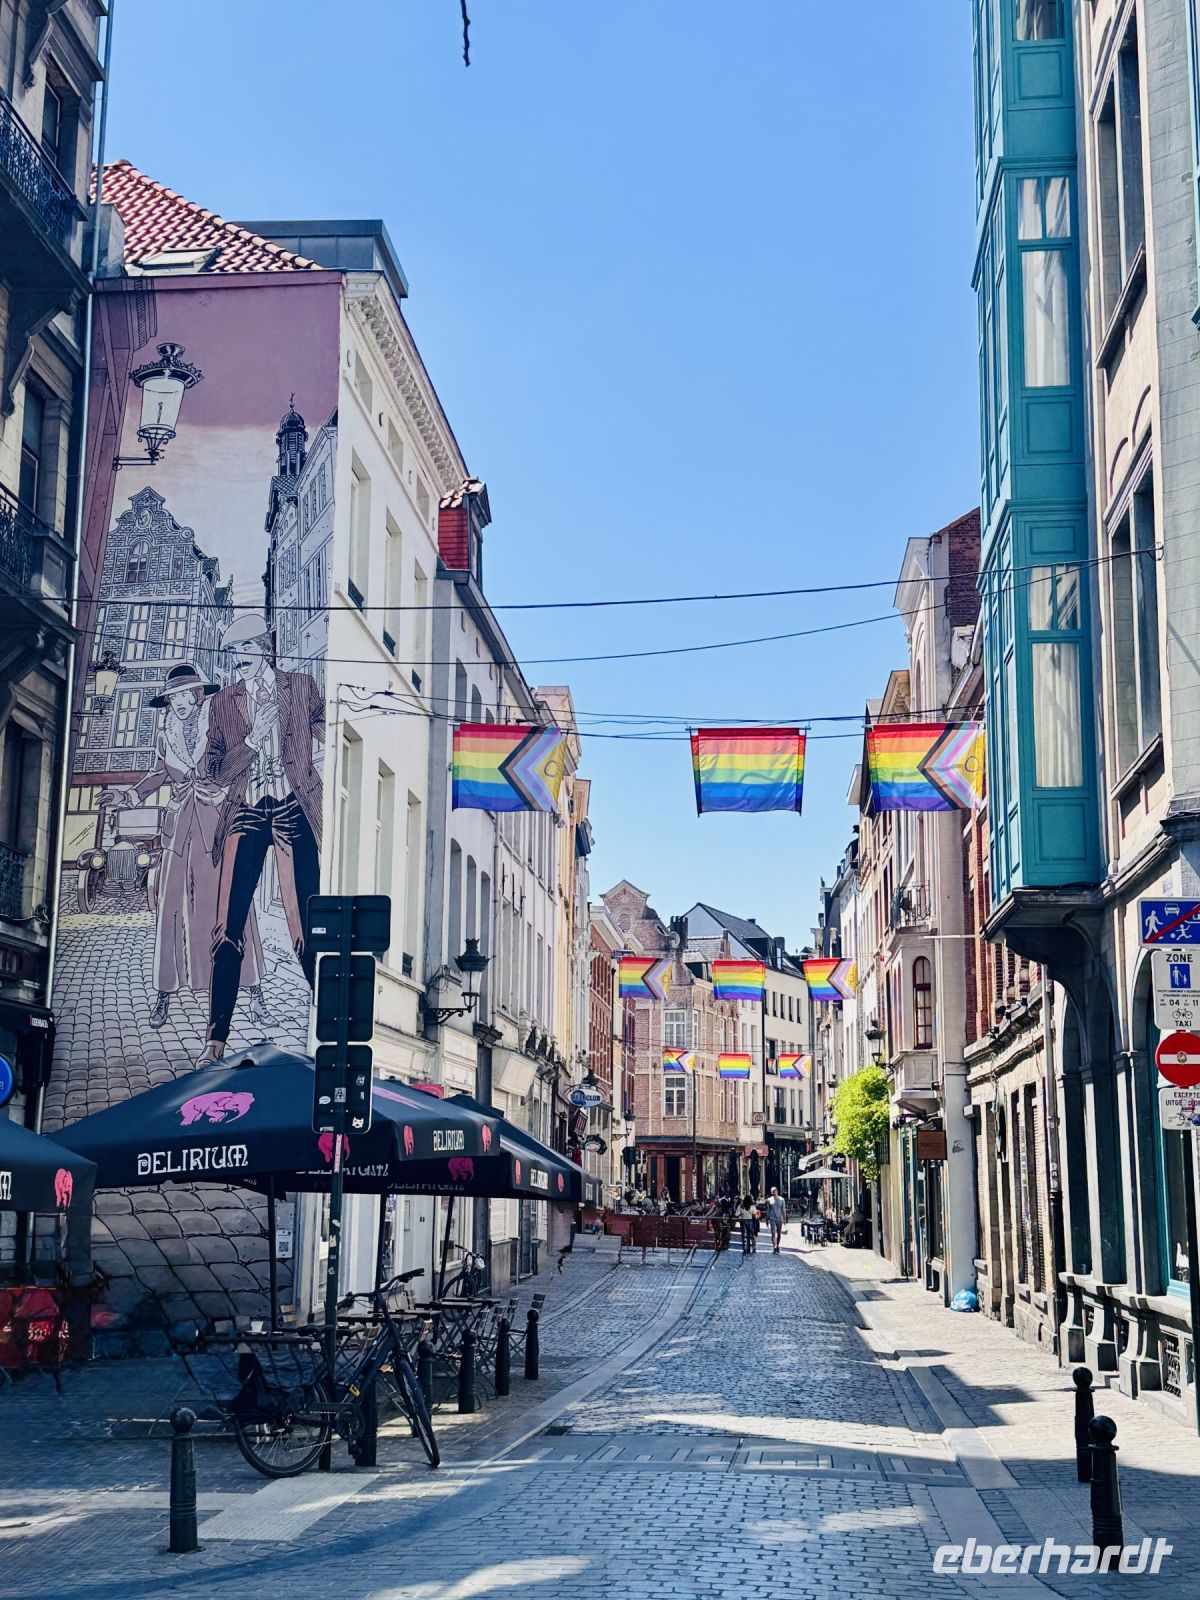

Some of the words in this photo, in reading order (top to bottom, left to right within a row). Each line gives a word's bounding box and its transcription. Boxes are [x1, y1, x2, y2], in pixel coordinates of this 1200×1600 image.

[1166, 954, 1193, 962] ZONE
[433, 1130, 465, 1151] DELIRIUM
[137, 1144, 249, 1175] DELIRIUM
